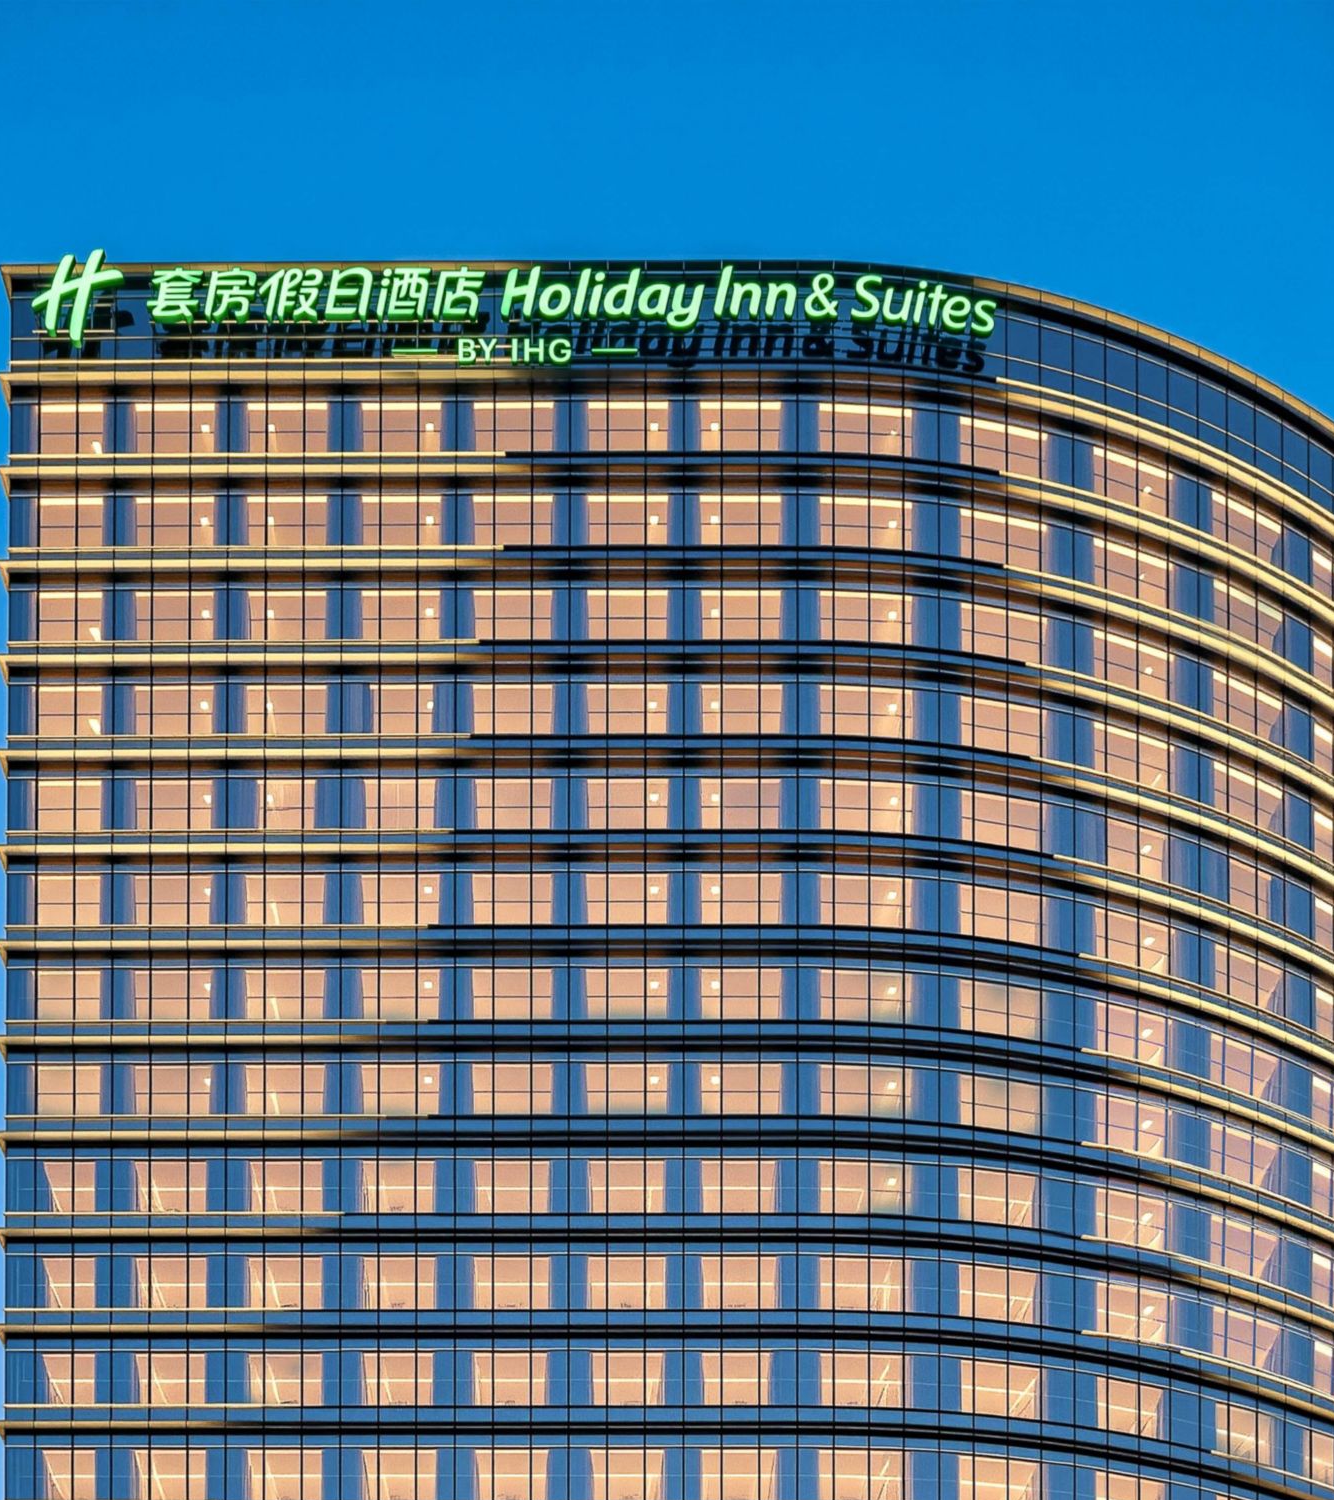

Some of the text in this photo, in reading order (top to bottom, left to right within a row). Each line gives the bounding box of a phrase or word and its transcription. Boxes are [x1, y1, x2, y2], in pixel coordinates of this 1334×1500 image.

[147, 265, 486, 324] 套房假日酒店
[500, 264, 998, 336] Holiday Inn & Suites
[457, 337, 573, 364] BY IHG
